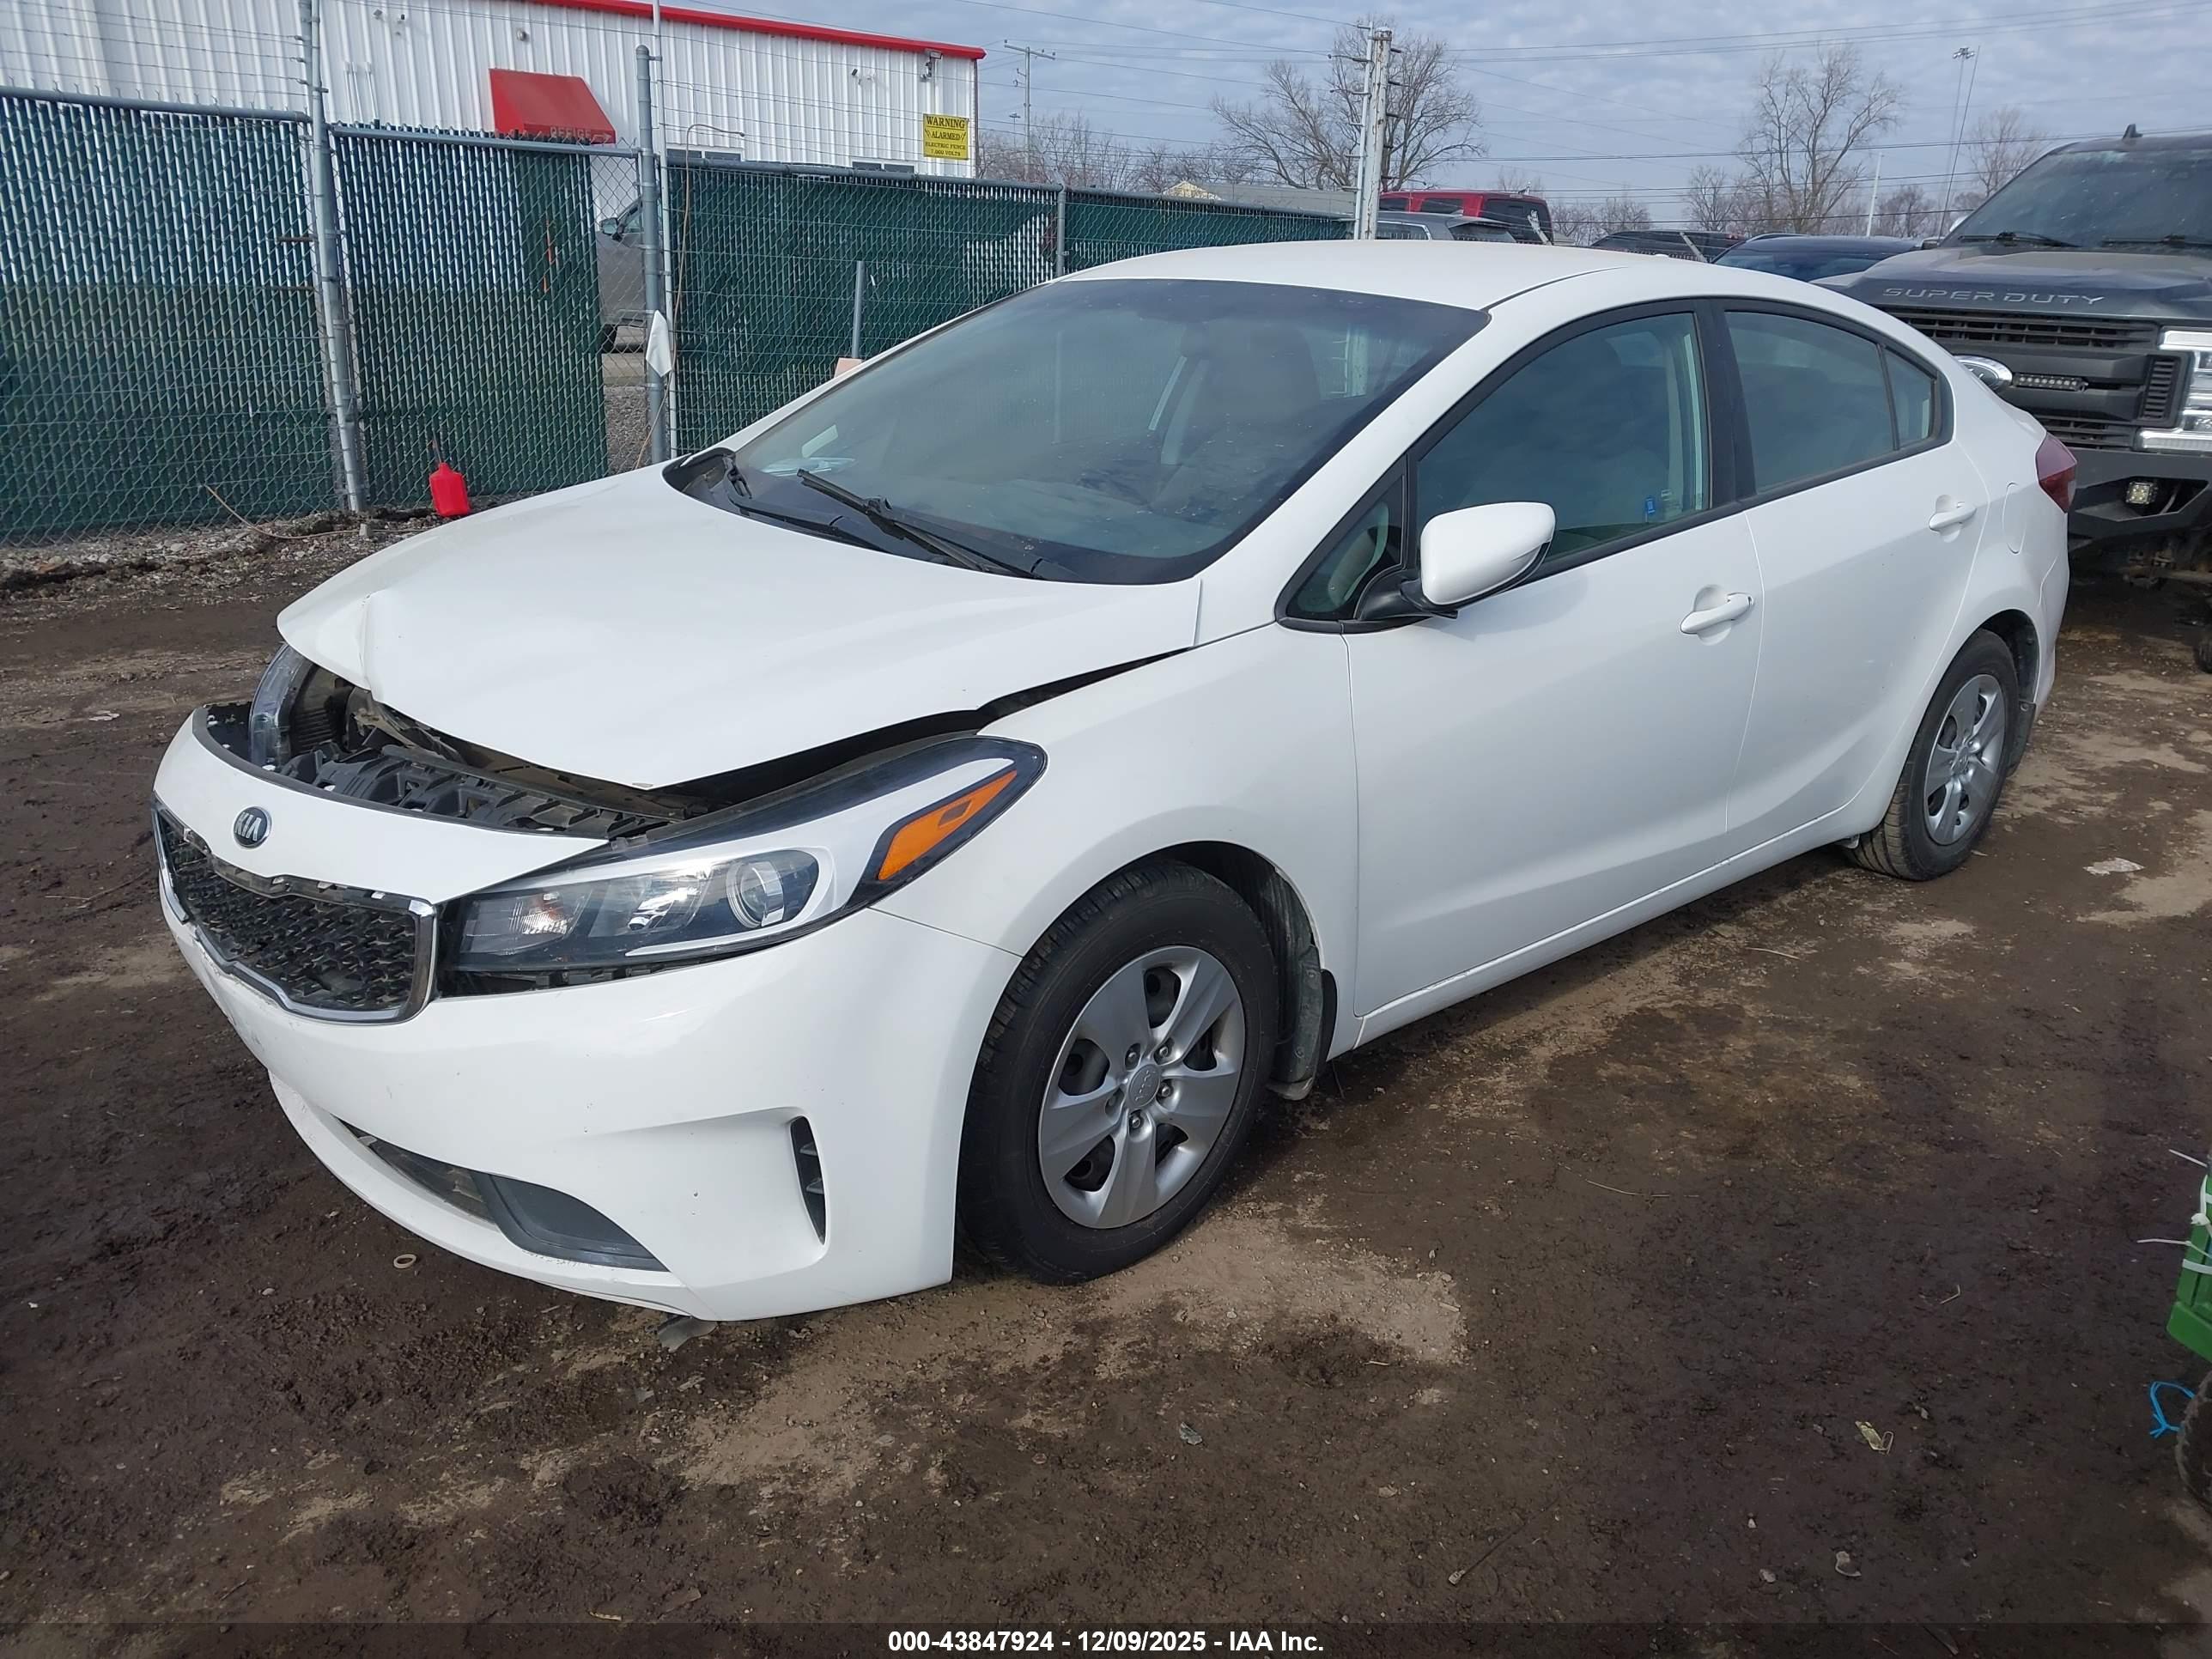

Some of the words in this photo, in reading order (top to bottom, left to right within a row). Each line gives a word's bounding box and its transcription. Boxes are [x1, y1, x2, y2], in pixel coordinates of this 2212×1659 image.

[927, 116, 965, 129] WARNING
[550, 126, 591, 138] OFFICE
[931, 131, 961, 141] ALARMED
[1882, 288, 1996, 301] SUPER
[2003, 293, 2105, 305] DUTY
[234, 811, 262, 842] KIA
